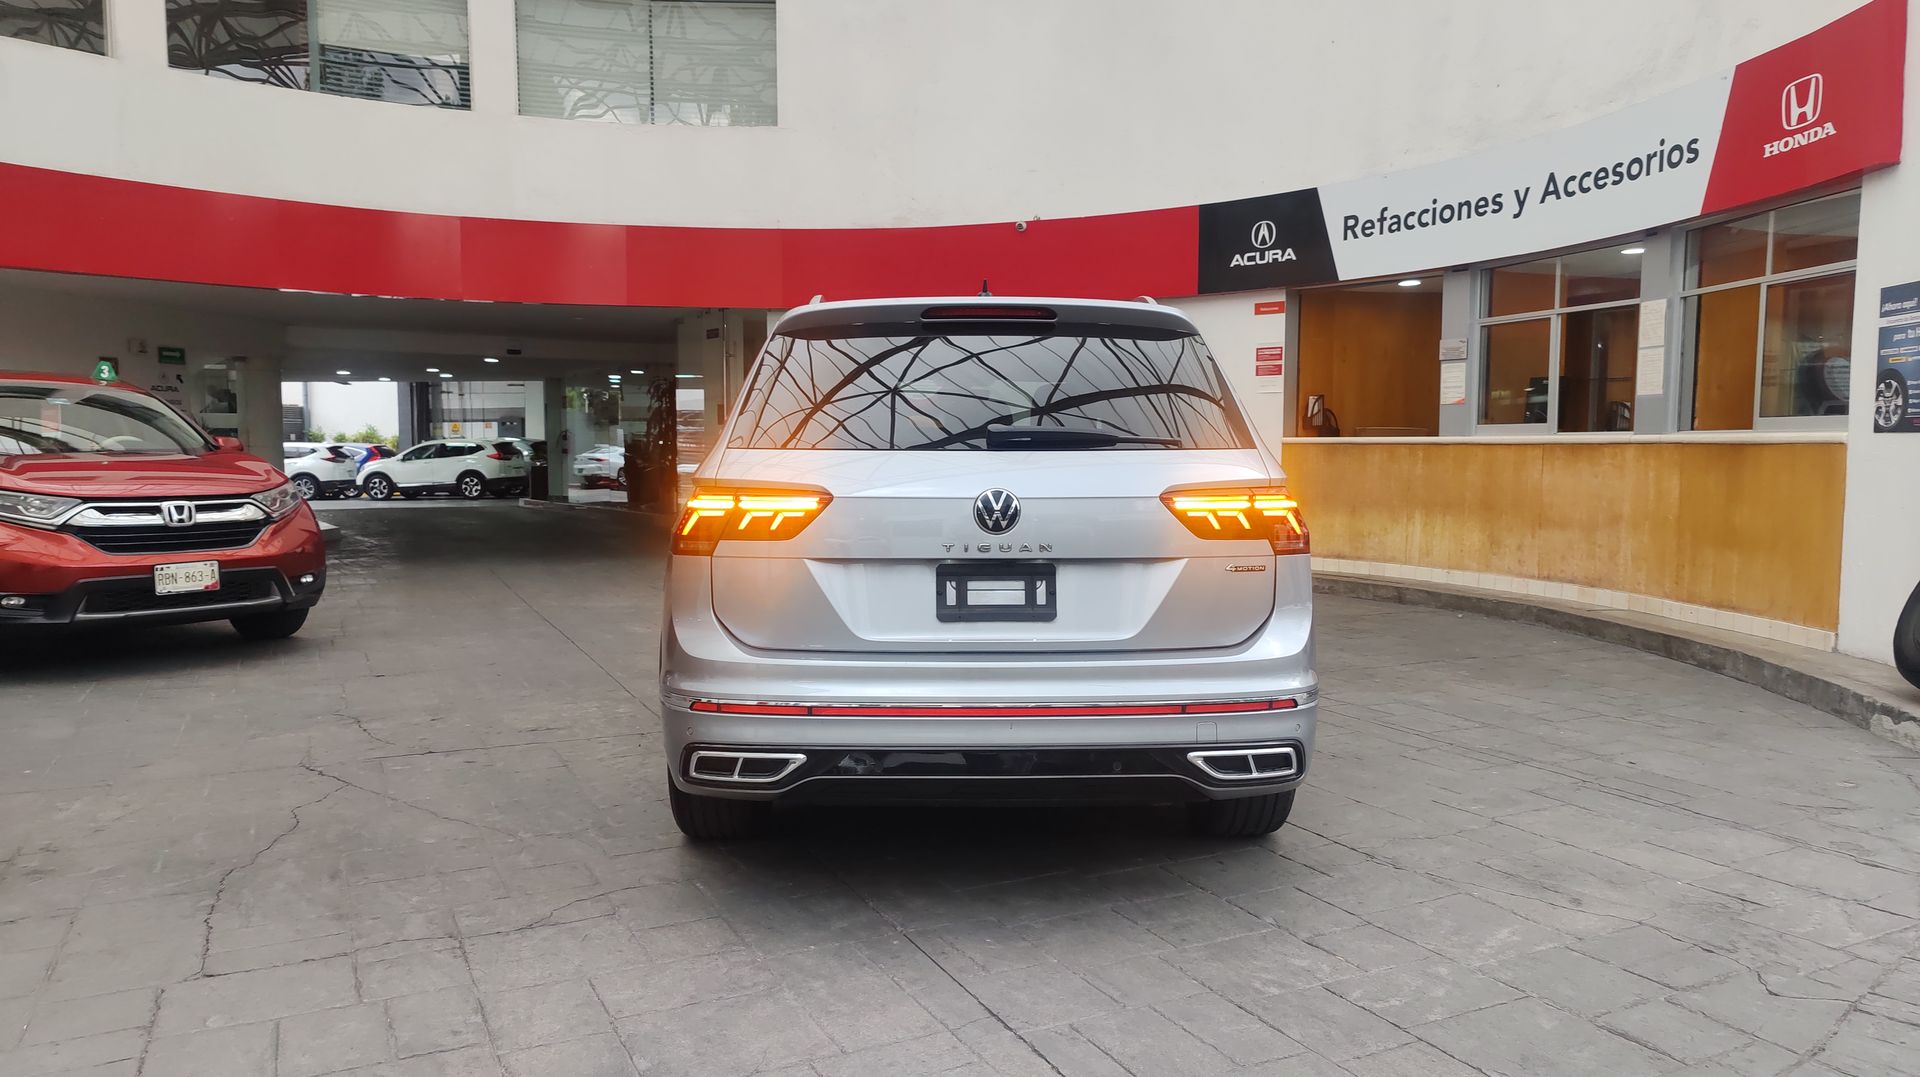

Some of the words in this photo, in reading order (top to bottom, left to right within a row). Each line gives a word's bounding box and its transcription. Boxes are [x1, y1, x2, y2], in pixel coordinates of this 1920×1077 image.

[1763, 121, 1837, 158] HONDA
[1342, 191, 1504, 241] Refacciones
[1512, 187, 1531, 219] y
[1538, 137, 1700, 205] Accesorios
[1229, 247, 1297, 268] ACURA
[100, 365, 110, 378] 3
[150, 385, 180, 393] ACURA
[941, 543, 1053, 553] TIGUAN
